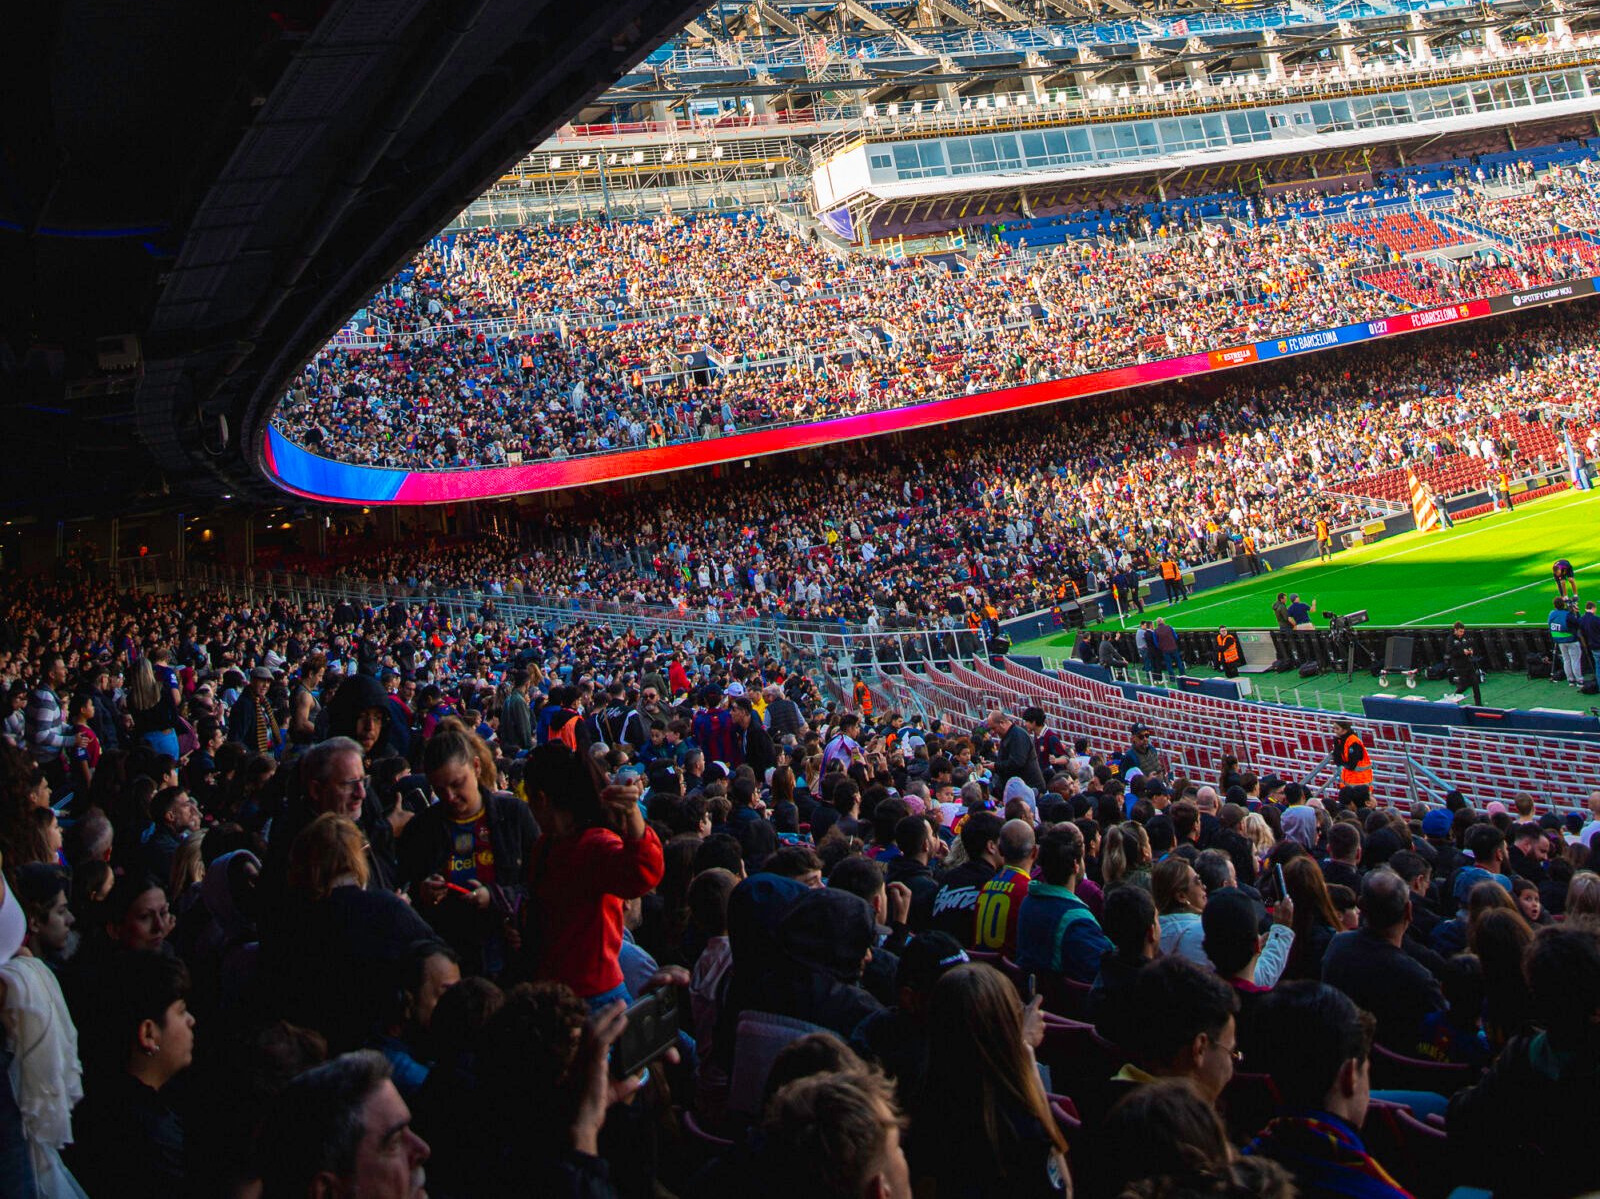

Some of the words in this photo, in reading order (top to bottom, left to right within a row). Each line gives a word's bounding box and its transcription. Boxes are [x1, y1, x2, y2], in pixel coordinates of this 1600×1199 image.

[1520, 292, 1544, 303] SPOTIFY
[1543, 288, 1560, 299] CAMP
[1560, 286, 1573, 296] NOU
[1411, 313, 1421, 327] FC
[1420, 307, 1459, 326] BARCELONA
[1368, 321, 1388, 335] 01:27
[1288, 340, 1299, 352] FC
[1299, 331, 1339, 350] BARCELONA
[1223, 349, 1251, 361] ESTRELLA
[983, 880, 1016, 894] MESSI
[975, 892, 1012, 950] 10
